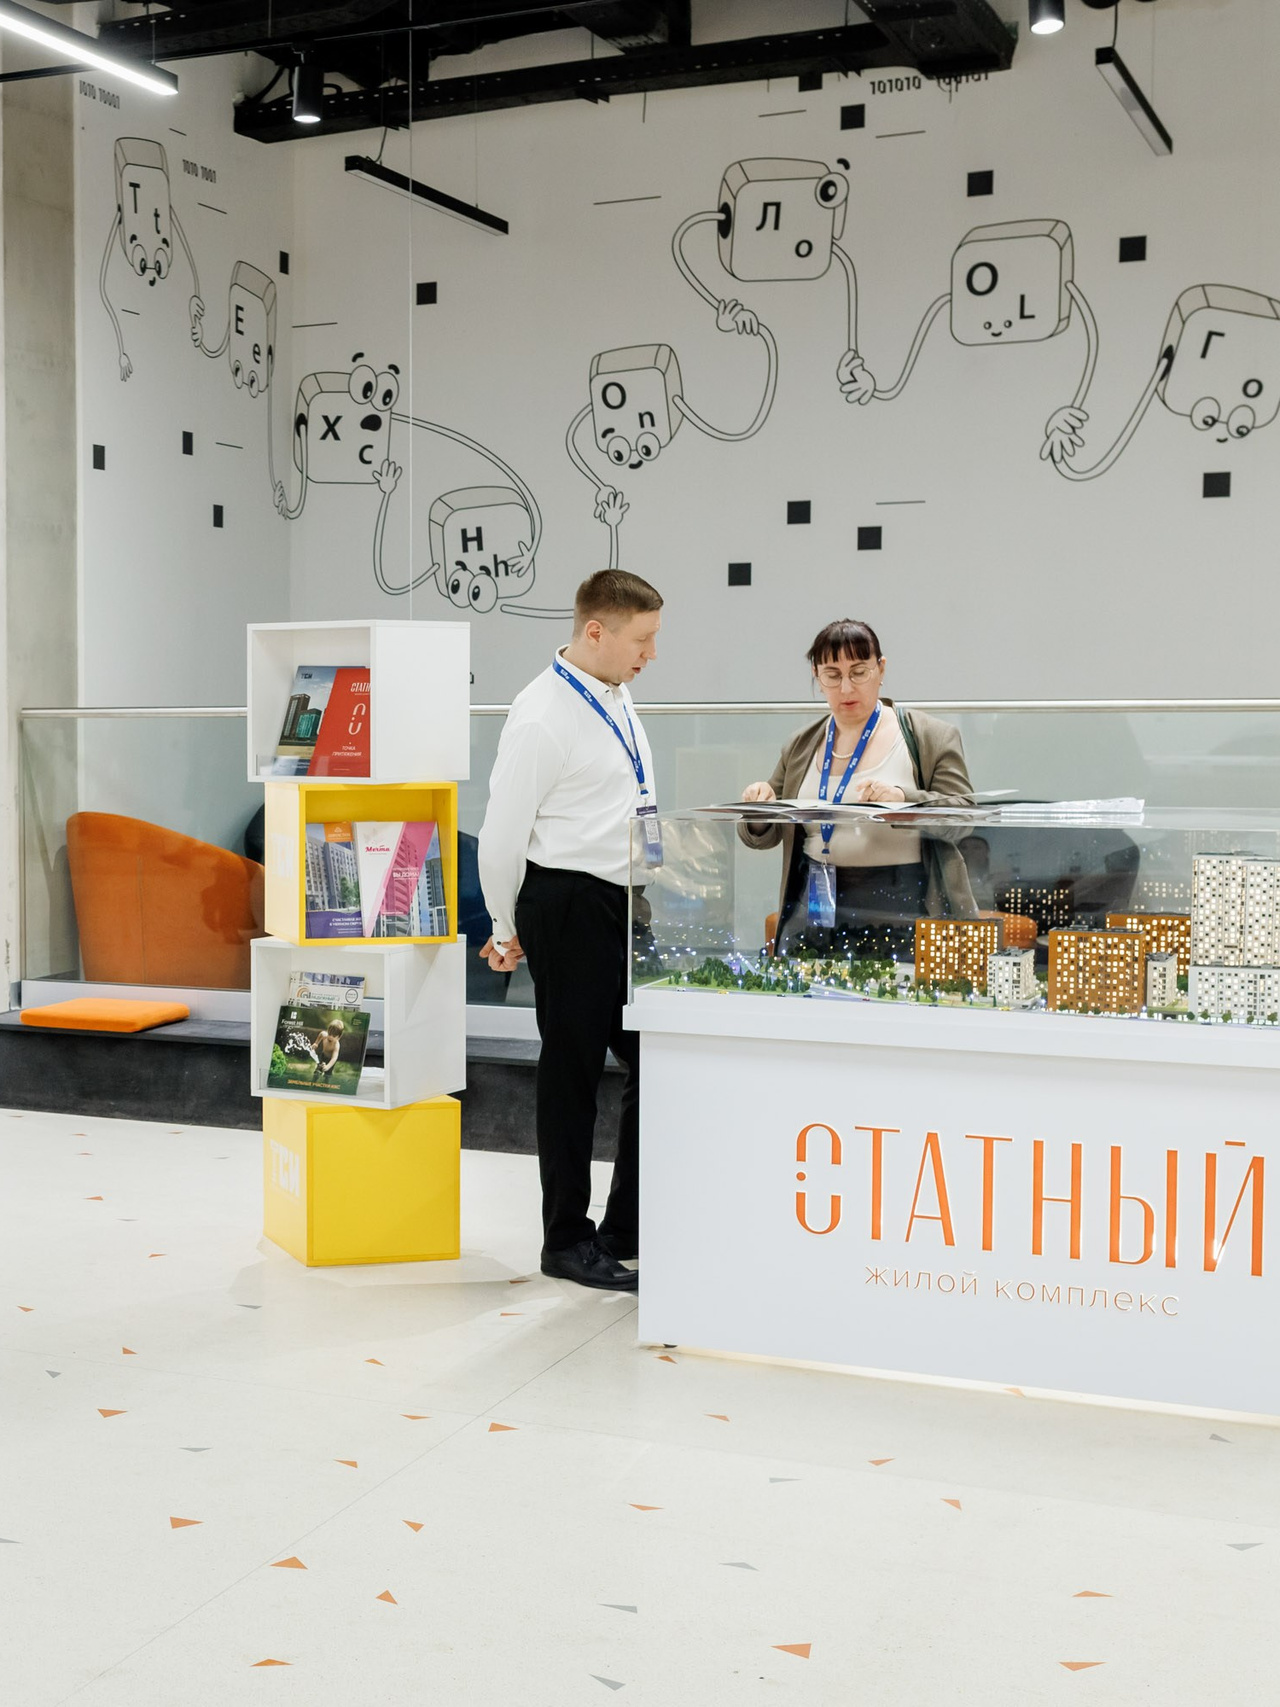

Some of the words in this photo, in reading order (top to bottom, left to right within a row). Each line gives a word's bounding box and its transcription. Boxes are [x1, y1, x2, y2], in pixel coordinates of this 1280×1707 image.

[870, 76, 921, 95] 101010
[755, 201, 782, 232] Л
[1019, 293, 1036, 320] L
[252, 342, 262, 365] e
[1200, 330, 1226, 359] Г
[638, 410, 656, 429] n
[795, 1122, 1266, 1277] СТАТНЫЙ
[864, 1265, 978, 1296] жилой
[995, 1278, 1180, 1317] комплекс
